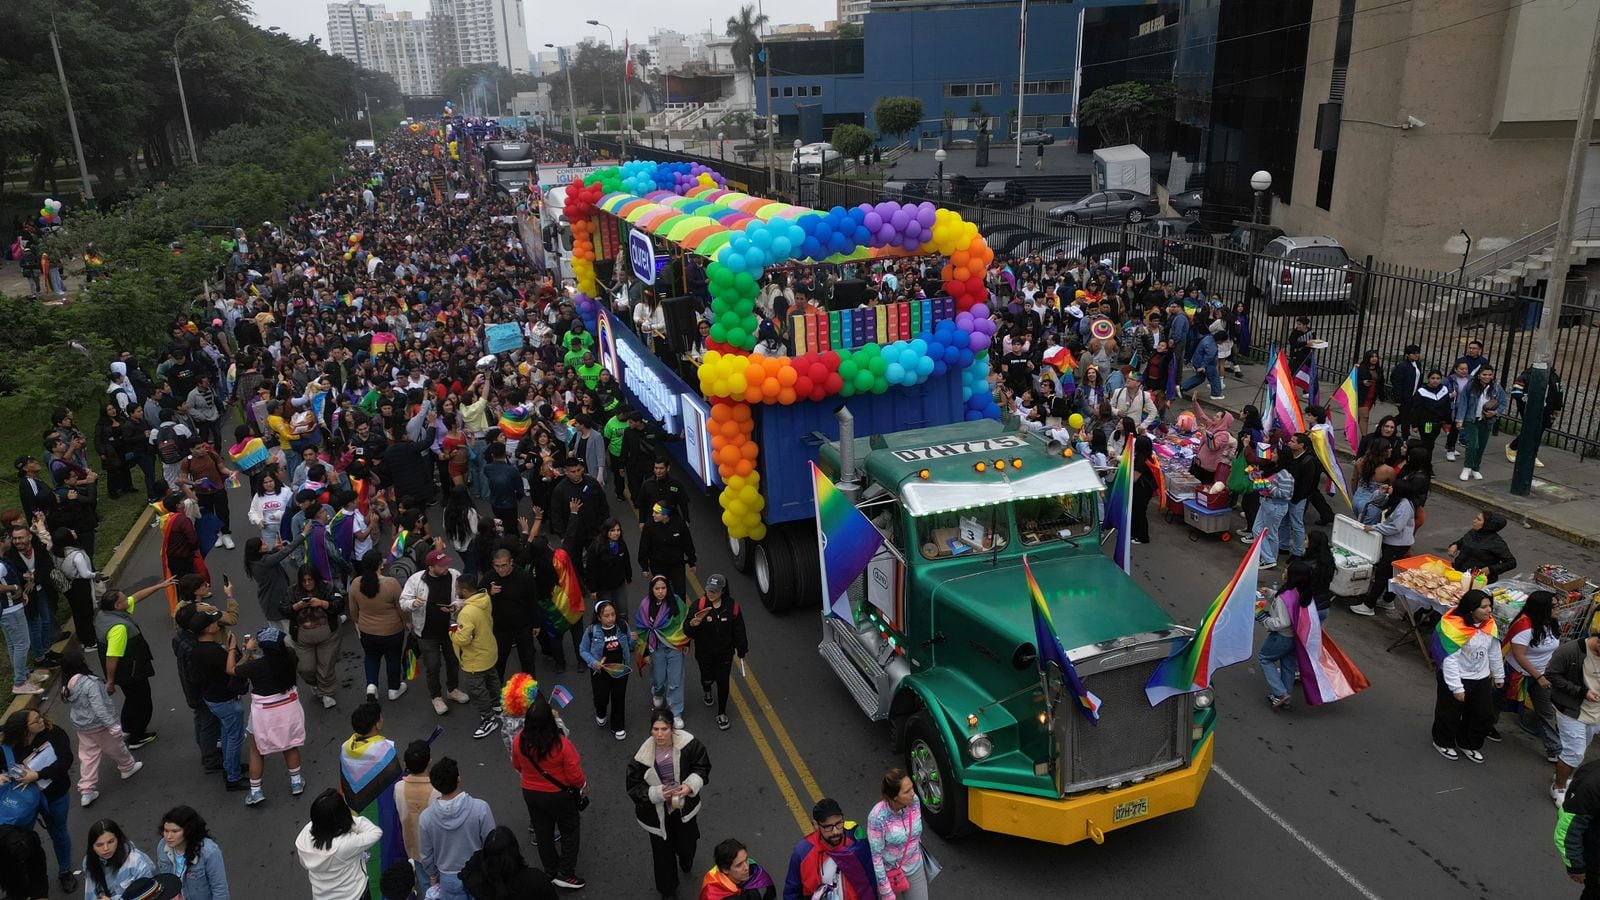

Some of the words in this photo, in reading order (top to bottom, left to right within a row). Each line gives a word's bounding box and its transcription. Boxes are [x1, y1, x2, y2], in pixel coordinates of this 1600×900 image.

[632, 239, 650, 275] durex
[896, 437, 1019, 461] D7H775
[967, 529, 975, 540] 3
